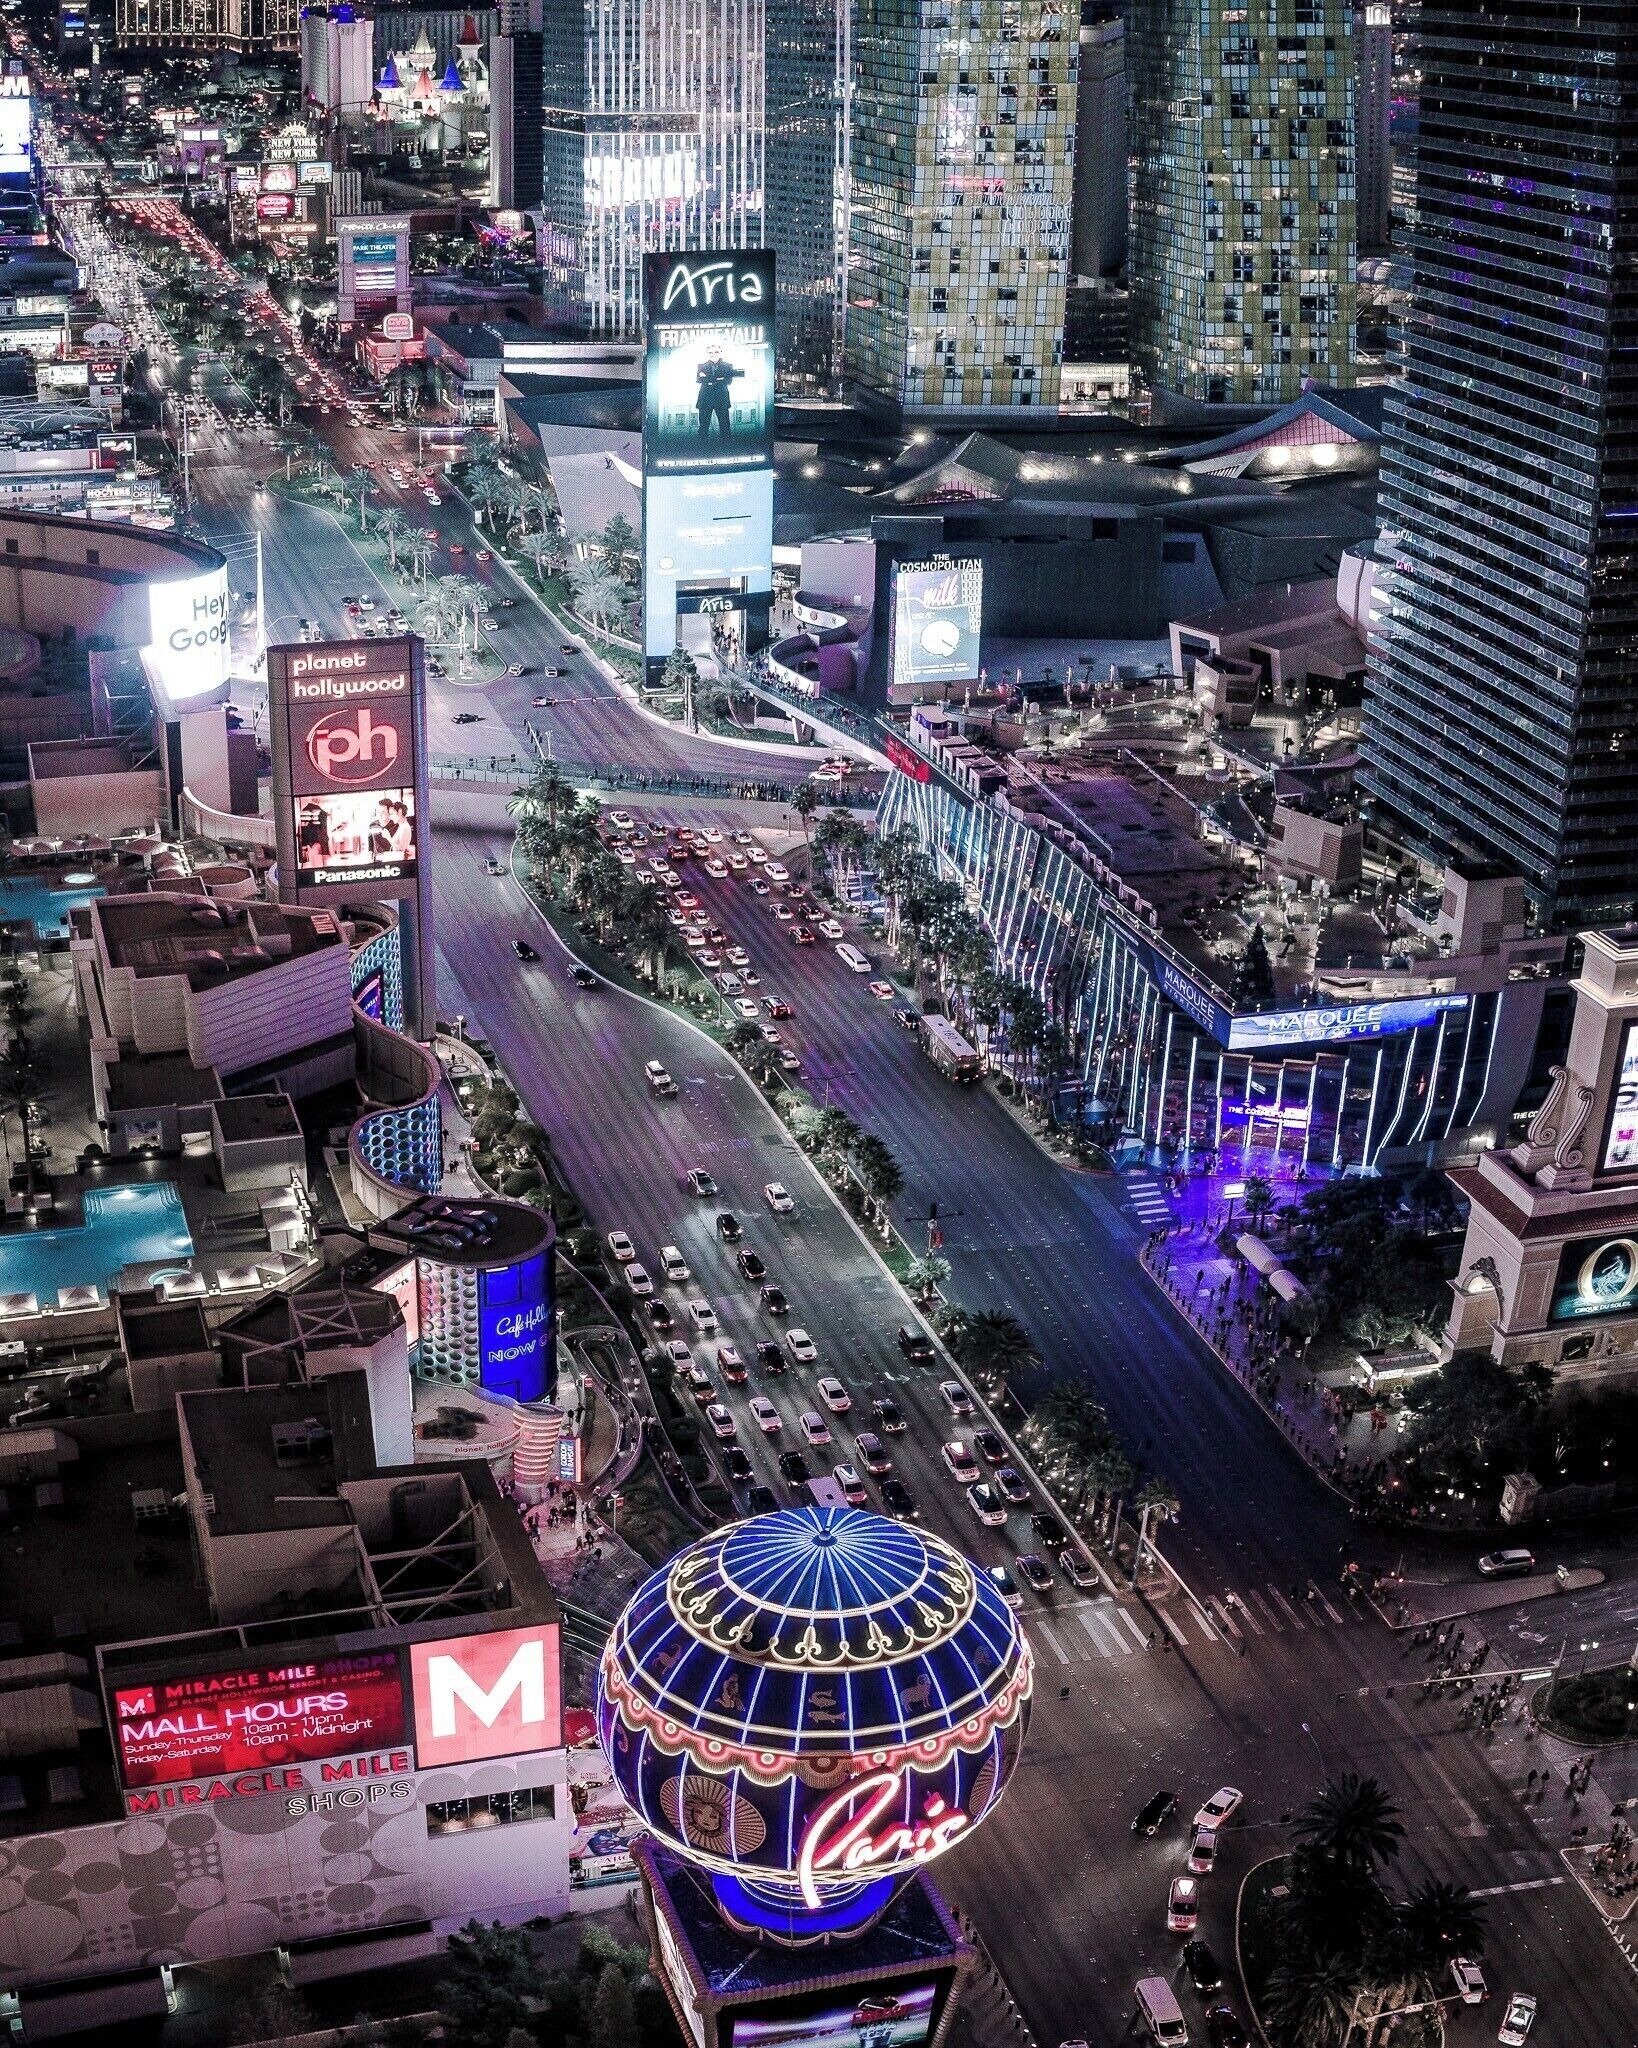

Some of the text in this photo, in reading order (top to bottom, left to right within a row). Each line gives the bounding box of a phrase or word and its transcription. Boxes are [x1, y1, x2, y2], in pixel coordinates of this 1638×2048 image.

[271, 137, 317, 147] NEW YORK
[271, 149, 317, 159] NEW YORK
[664, 262, 762, 310] Aria
[87, 489, 130, 497] HOOTERS
[900, 559, 982, 573] COSMOPOLITAN
[933, 553, 950, 561] THE
[699, 597, 734, 613] Aria
[293, 653, 366, 676] planet
[294, 675, 405, 698] hollywood
[316, 708, 398, 774] ph
[314, 865, 400, 884] Panasonic
[1164, 966, 1215, 1020] MARQUEE
[1269, 1007, 1382, 1031] MARQUEE
[1228, 1106, 1244, 1114] THE
[1575, 1305, 1599, 1314] CIRQUE
[1610, 1301, 1632, 1309] SOLEIL
[497, 1313, 525, 1338] Café
[489, 1340, 536, 1362] NOW
[454, 1446, 484, 1454] planet
[165, 1673, 260, 1698] MIRACLE
[268, 1665, 317, 1683] MILE
[289, 1678, 328, 1690] RESORT
[428, 1641, 546, 1738] M
[122, 1691, 349, 1743] MALL HOURS
[124, 1731, 233, 1754] Sunday-Thursday
[240, 1722, 287, 1736] 10am
[301, 1713, 344, 1728] 11pm
[126, 1744, 223, 1766] Friday-Saturday
[242, 1733, 289, 1747] 10am
[302, 1718, 373, 1738] Midnight
[124, 1751, 411, 1814] MIRACLE MILE
[288, 1781, 412, 1816] SHOPS
[801, 1773, 967, 1909] Paris
